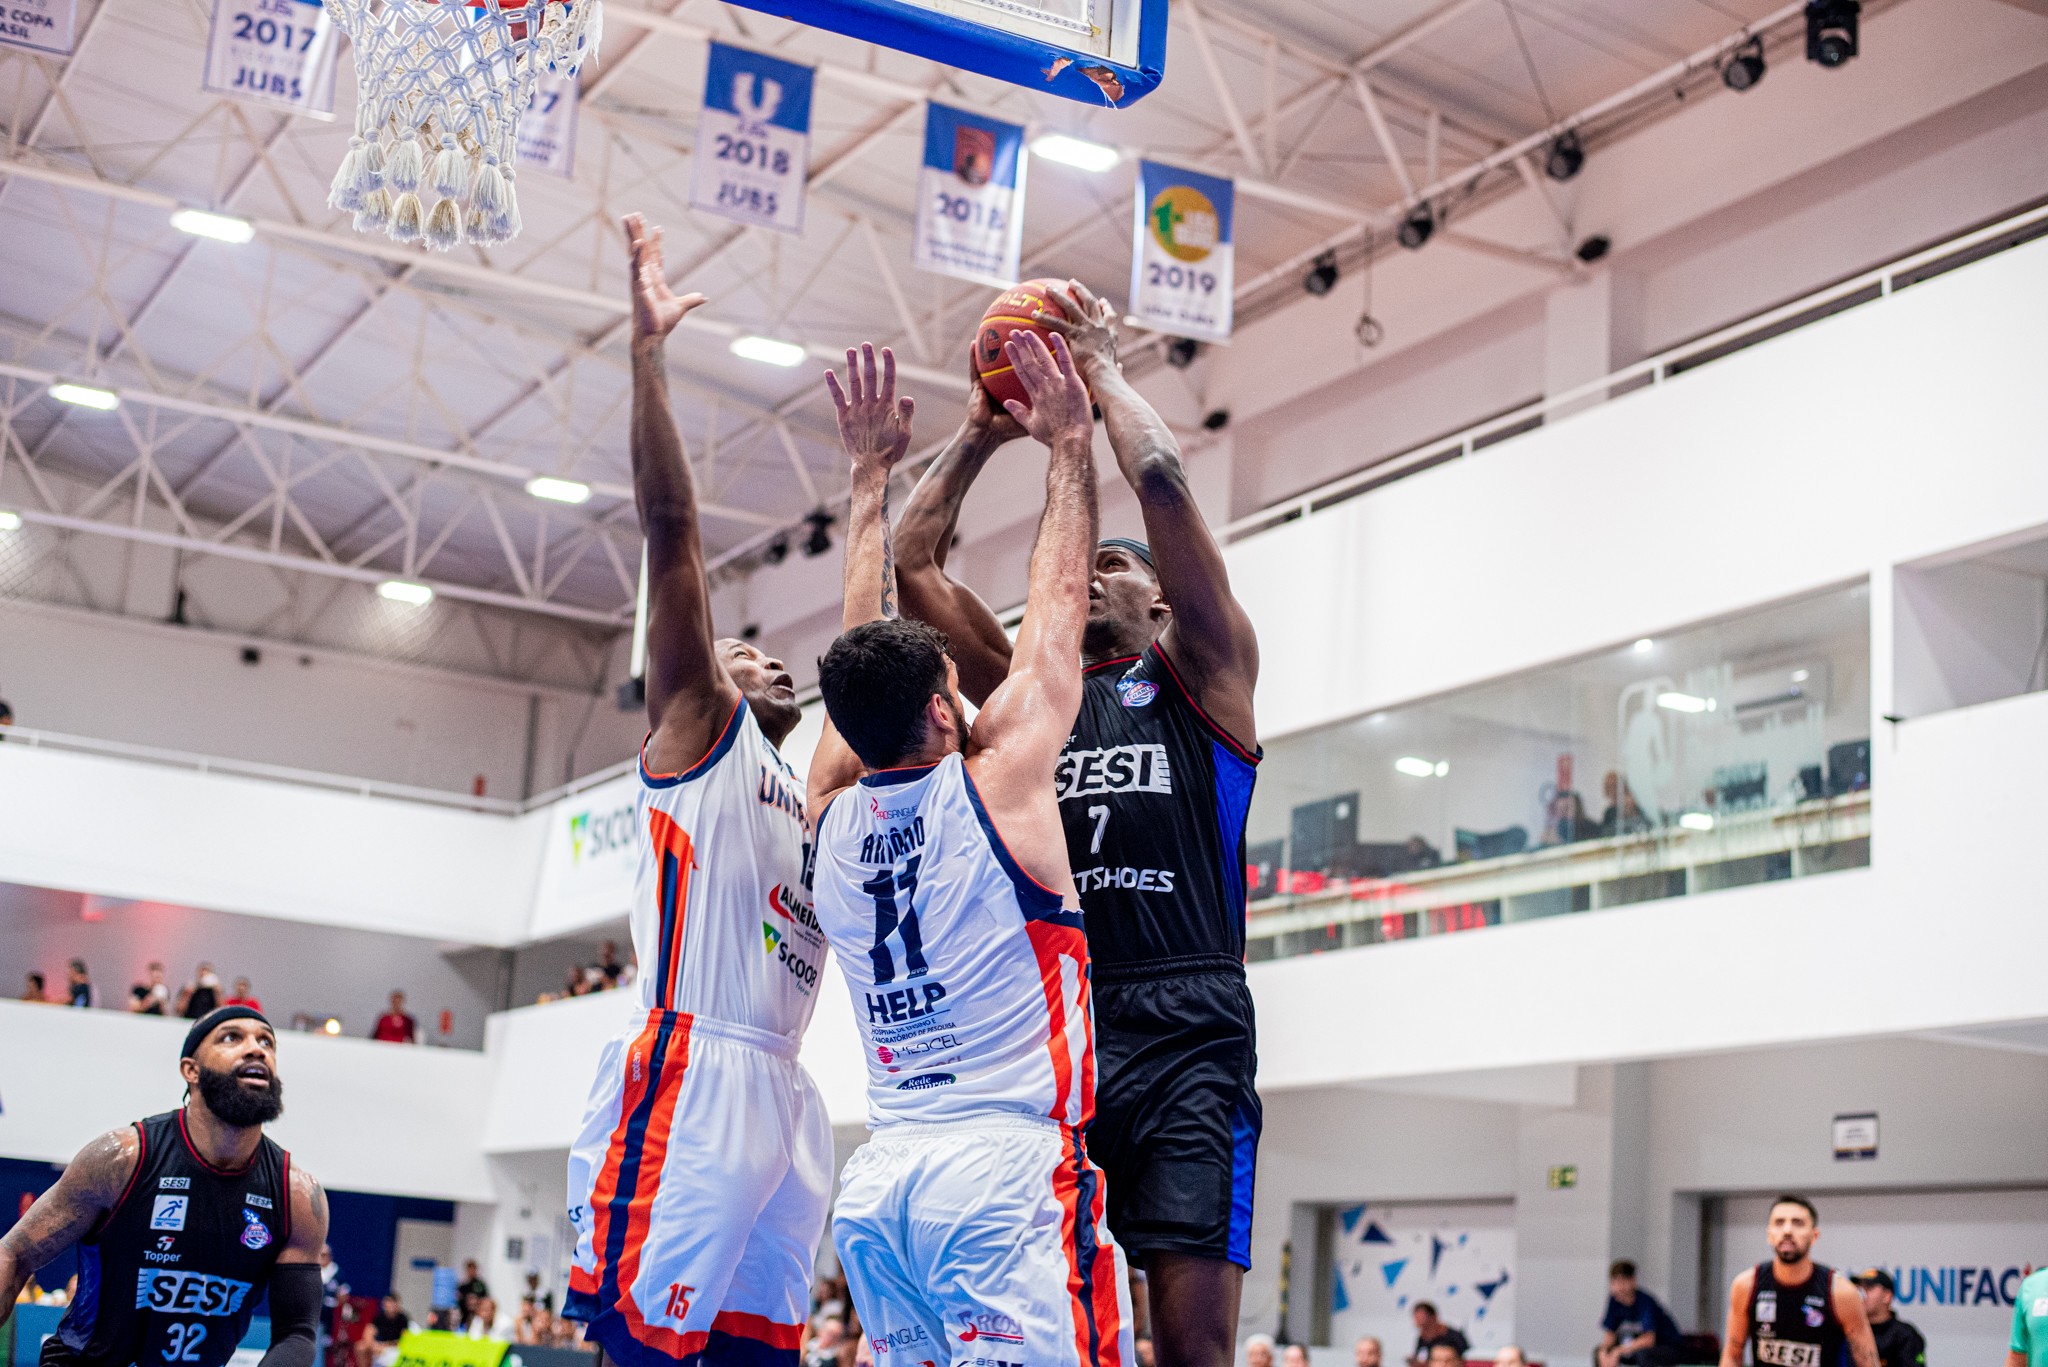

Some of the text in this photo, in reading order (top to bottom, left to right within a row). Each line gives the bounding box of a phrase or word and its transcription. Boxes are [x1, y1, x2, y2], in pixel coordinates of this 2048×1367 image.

[11, 9, 54, 29] COPA
[234, 12, 317, 53] 2017
[232, 67, 302, 99] JUBS
[716, 133, 790, 174] 2018
[716, 180, 778, 215] JUBS
[1148, 261, 1217, 297] 2019
[1055, 753, 1153, 798] SESI
[876, 806, 918, 819] PROSANGUE
[1088, 804, 1111, 854] 7
[1072, 866, 1175, 893] TSHOES
[863, 855, 929, 986] 11
[866, 982, 947, 1024] HELP
[871, 1027, 896, 1036] HOSPITAL
[905, 1020, 932, 1031] ENSINO
[927, 1022, 957, 1034] PESQUISA
[908, 1076, 931, 1087] Rede
[162, 1180, 187, 1188] SESI
[144, 1250, 181, 1264] Topper
[148, 1275, 240, 1313] SESI
[665, 1283, 695, 1320] 15
[161, 1322, 208, 1362] 32
